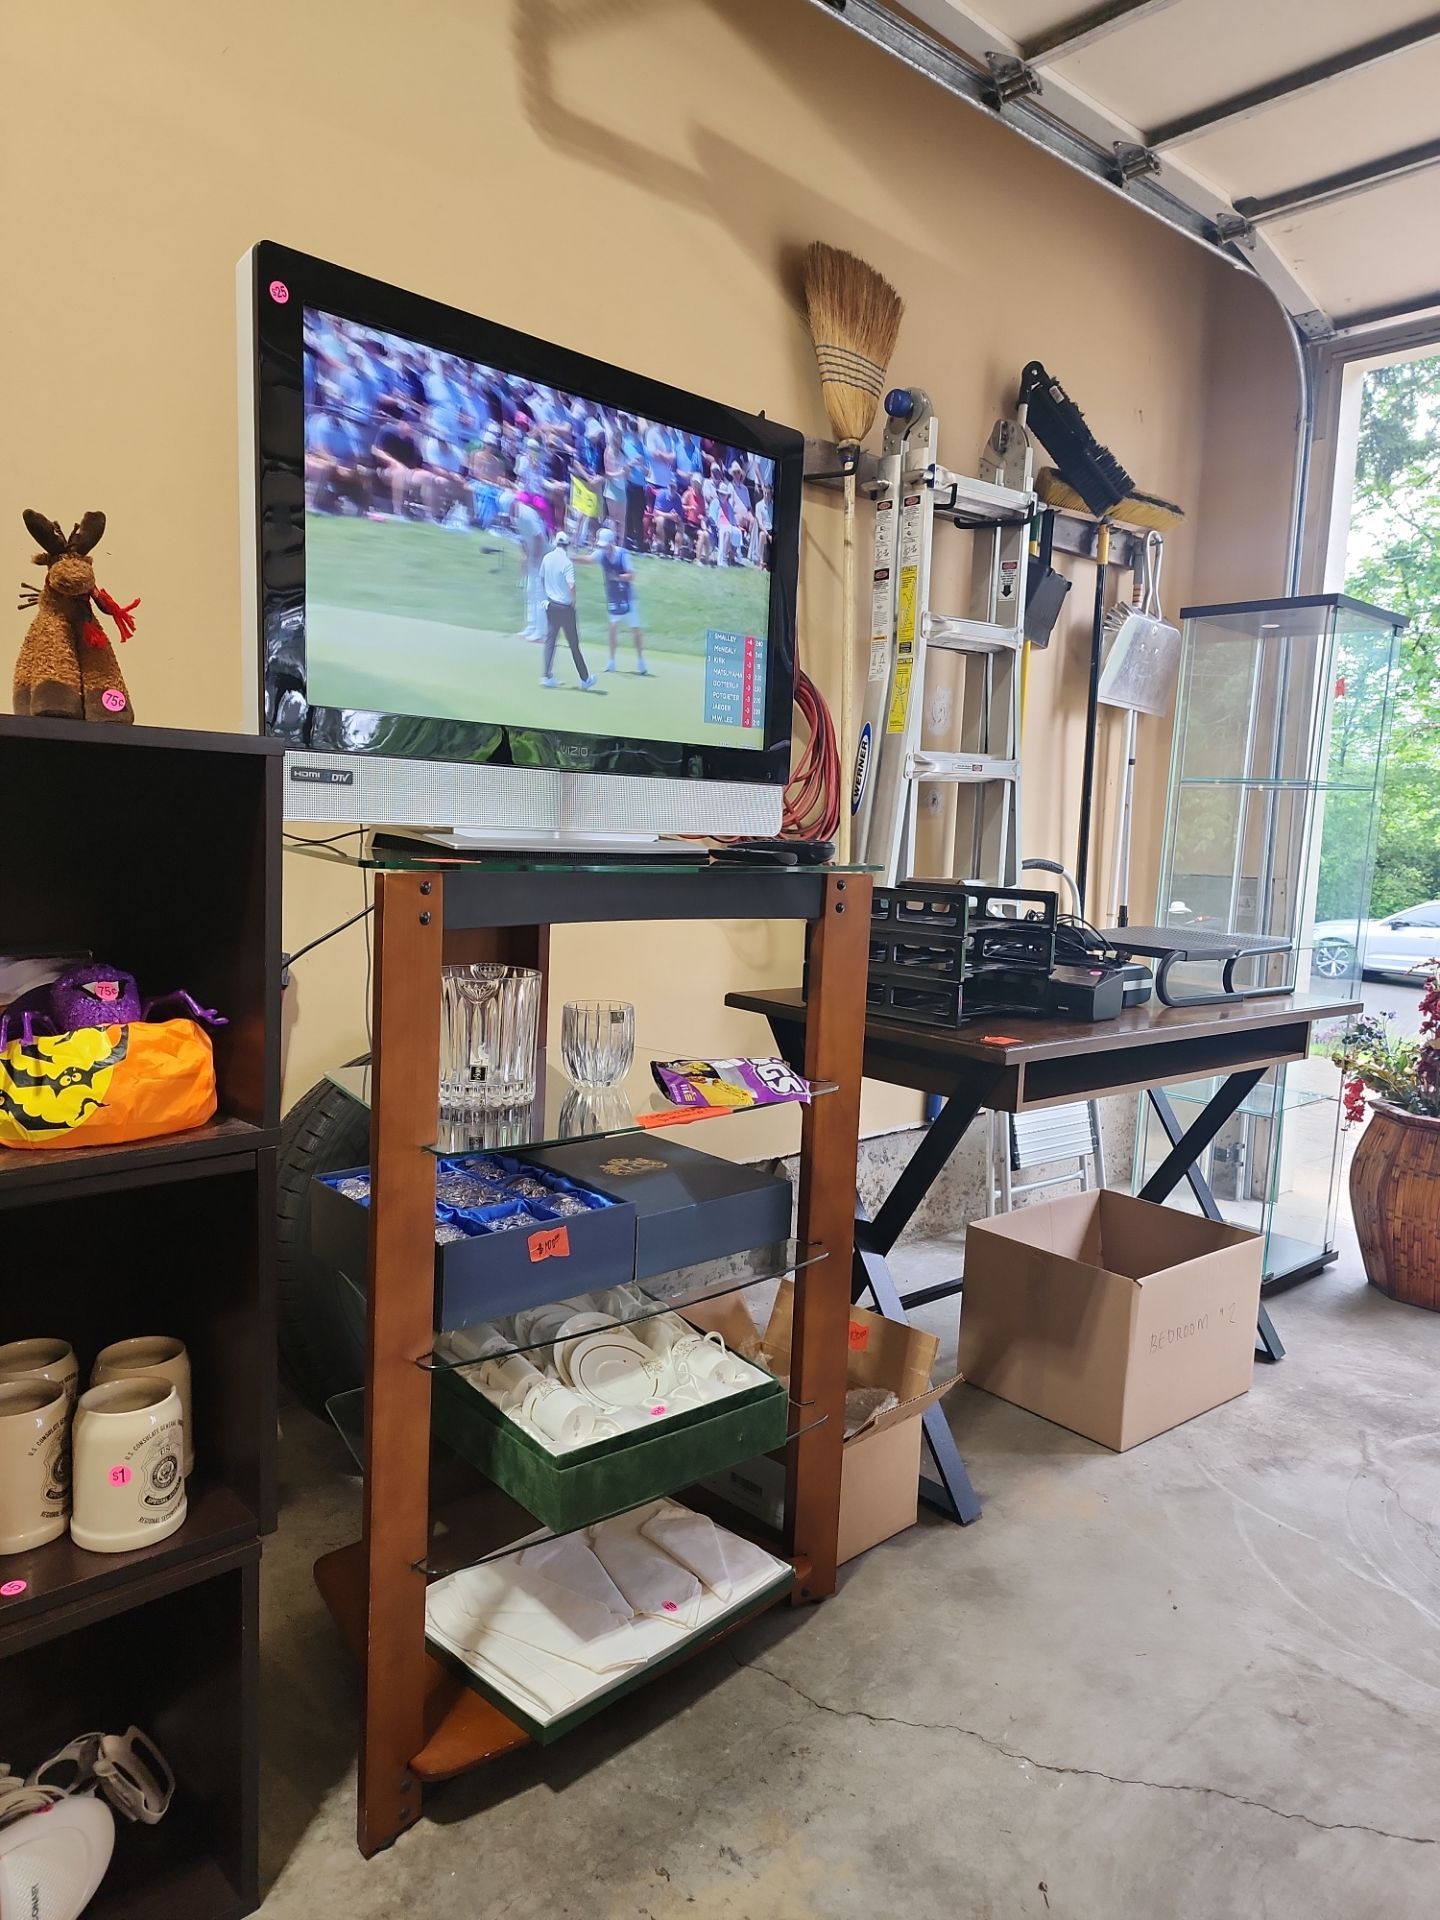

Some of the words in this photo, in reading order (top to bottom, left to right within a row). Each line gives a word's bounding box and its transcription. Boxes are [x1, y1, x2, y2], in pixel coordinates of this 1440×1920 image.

[271, 286, 287, 298] $25
[560, 744, 589, 756] VIZIO
[294, 770, 321, 778] HDMI
[332, 773, 351, 782] DTV
[853, 740, 868, 798] WERNER
[1149, 1314, 1209, 1354] BEDROOM
[133, 1428, 160, 1451] CONSULATE
[112, 1468, 126, 1483] $1
